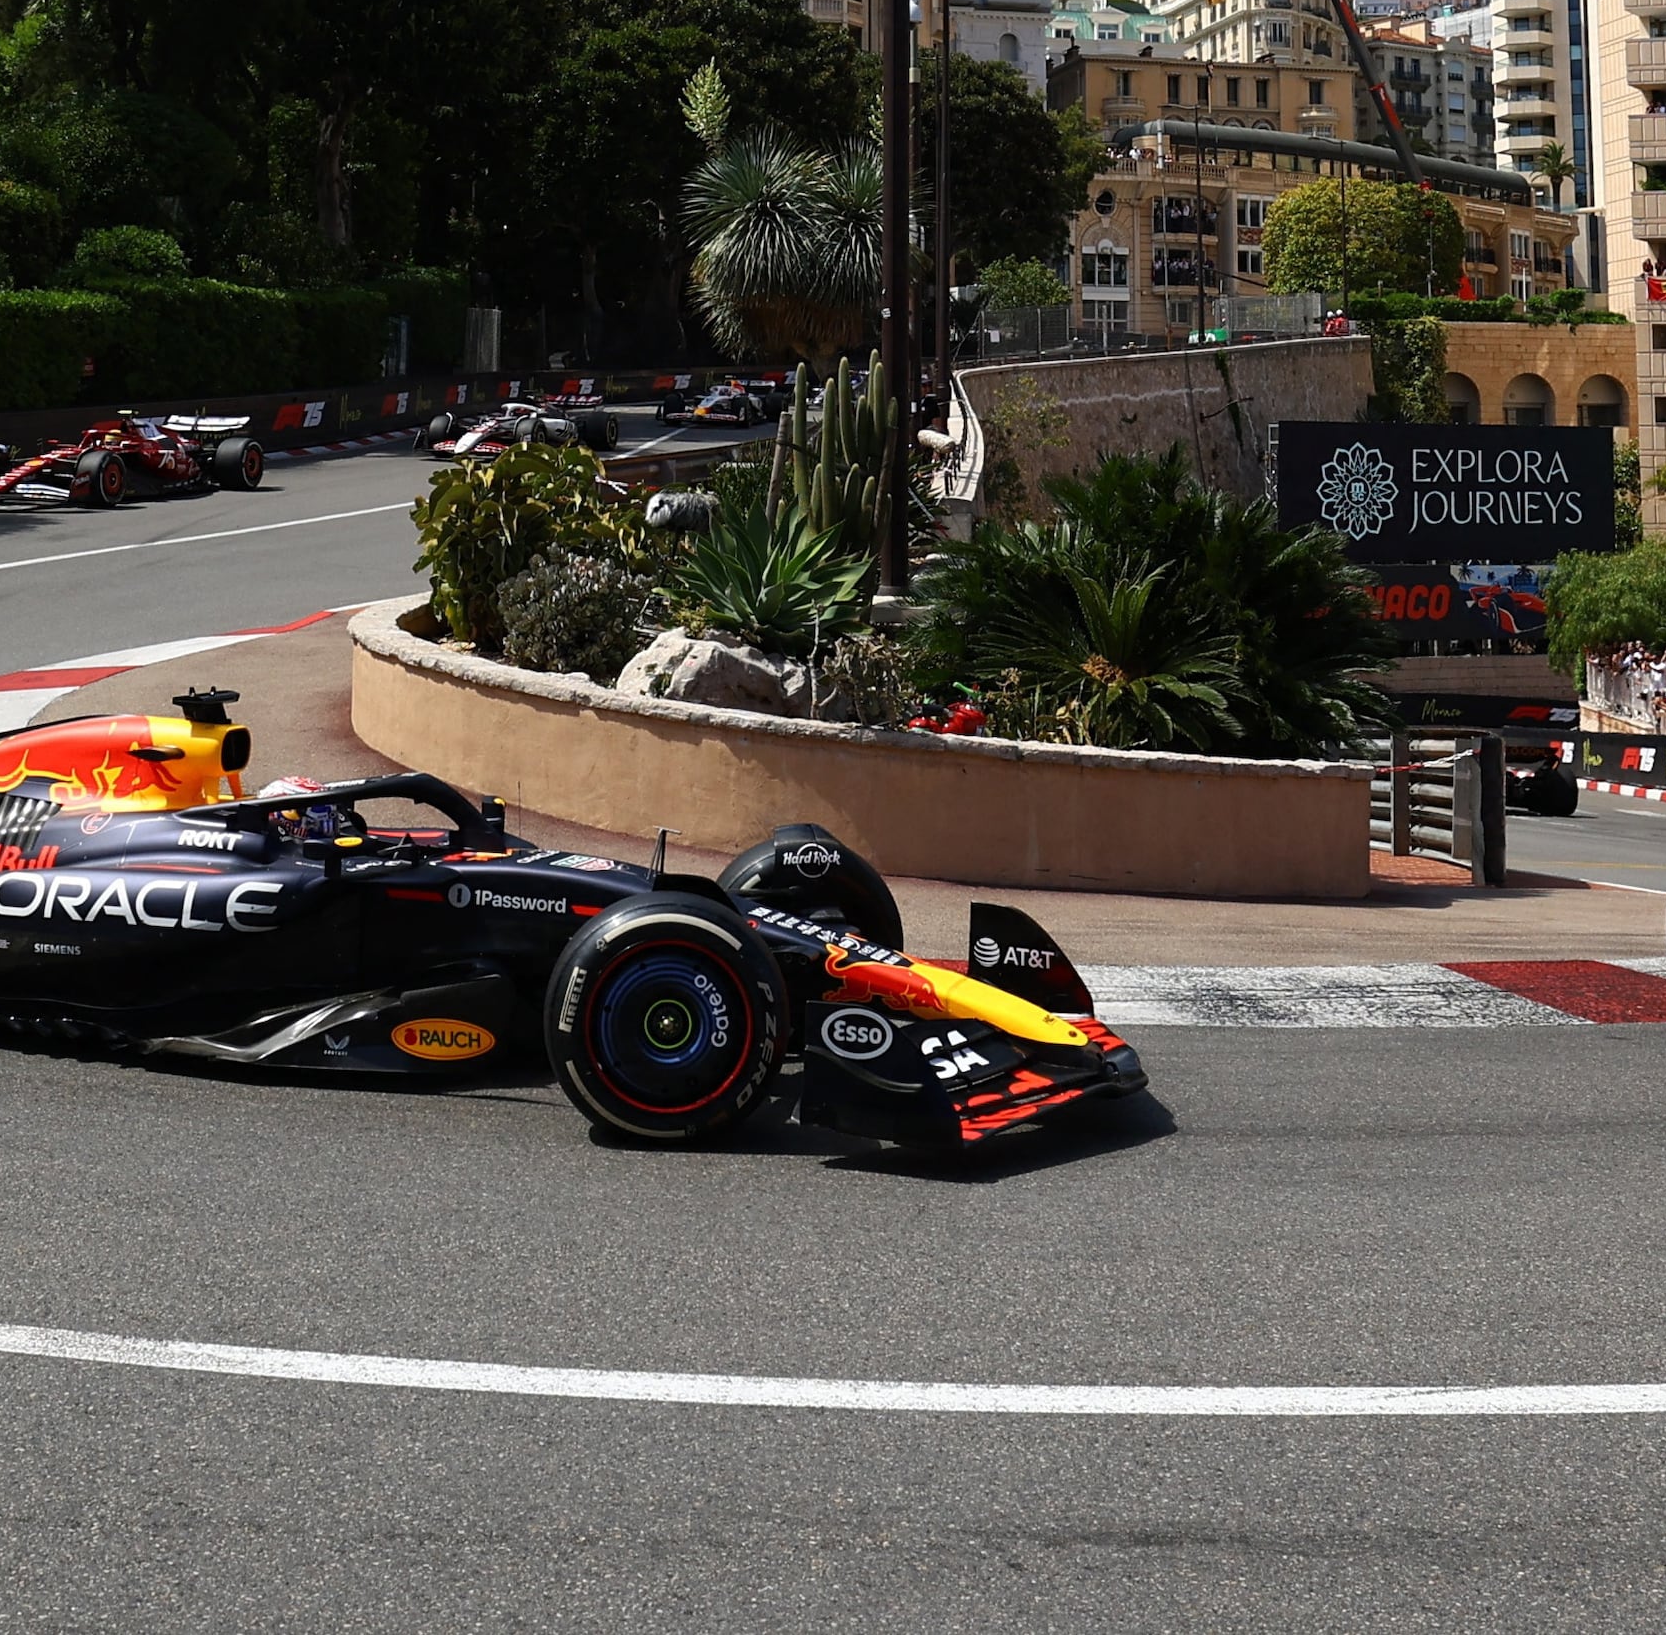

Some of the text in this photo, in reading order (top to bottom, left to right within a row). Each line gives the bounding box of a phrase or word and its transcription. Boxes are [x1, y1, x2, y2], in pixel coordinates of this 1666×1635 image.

[302, 401, 326, 428] 75
[1412, 448, 1571, 484] EXPLORA
[1408, 490, 1583, 534] JOURNEYS
[1360, 583, 1451, 622] NACO
[1639, 746, 1657, 773] 75
[178, 829, 242, 851] ROKT
[783, 850, 841, 865] Hard Rock
[475, 888, 567, 914] 1Password
[34, 942, 82, 956] SIEMENS
[1004, 946, 1055, 970] AT&T
[558, 966, 588, 1033] PIRELLI
[693, 974, 730, 1048] Gate.io
[419, 1029, 481, 1048] RAUCH
[833, 1019, 882, 1044] Esso
[735, 1011, 777, 1109] ZERO
[920, 1030, 990, 1080] SA
